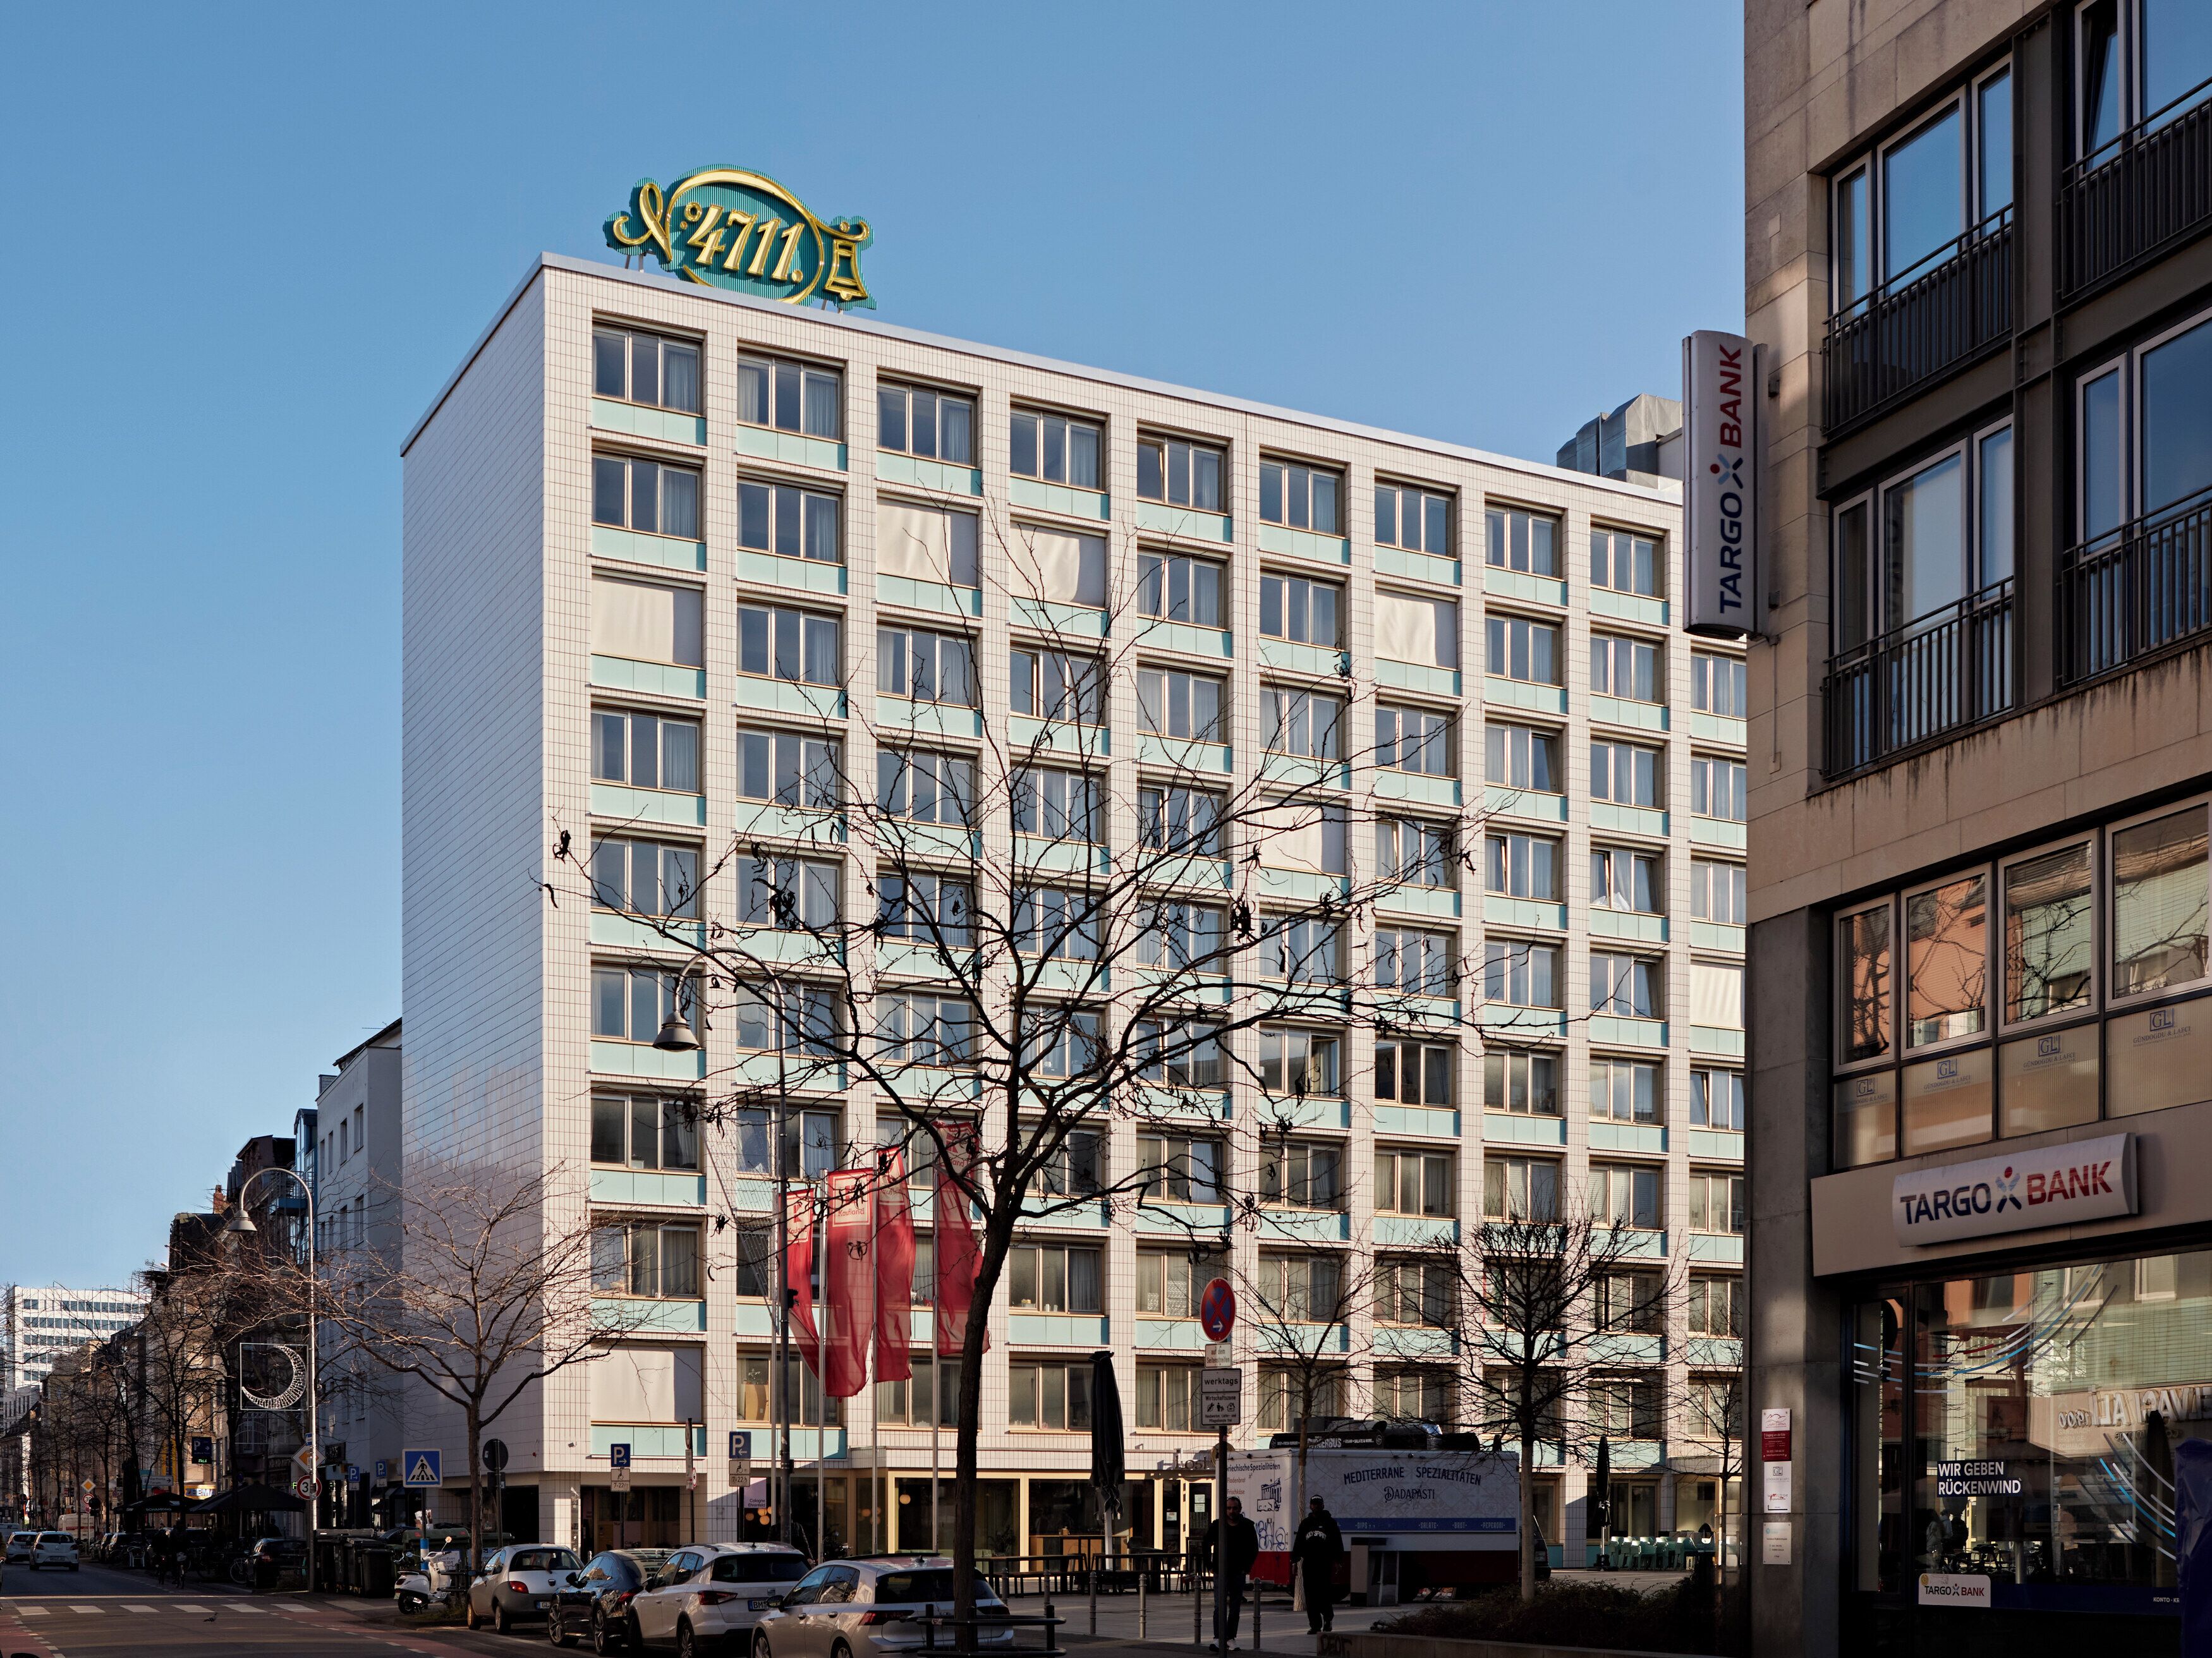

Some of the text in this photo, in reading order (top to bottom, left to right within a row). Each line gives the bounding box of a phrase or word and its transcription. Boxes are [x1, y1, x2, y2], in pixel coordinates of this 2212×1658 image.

[838, 1207, 865, 1216] Kaufland
[1204, 1377, 1238, 1386] werktags
[1250, 1463, 1280, 1472] Spezialitäten
[1938, 1461, 2004, 1477] WIR GEBEN
[1344, 1467, 1404, 1485] MEDITERRANE
[186, 1488, 216, 1496] ZEEMA
[1938, 1479, 2021, 1496] RÜCKENWIND
